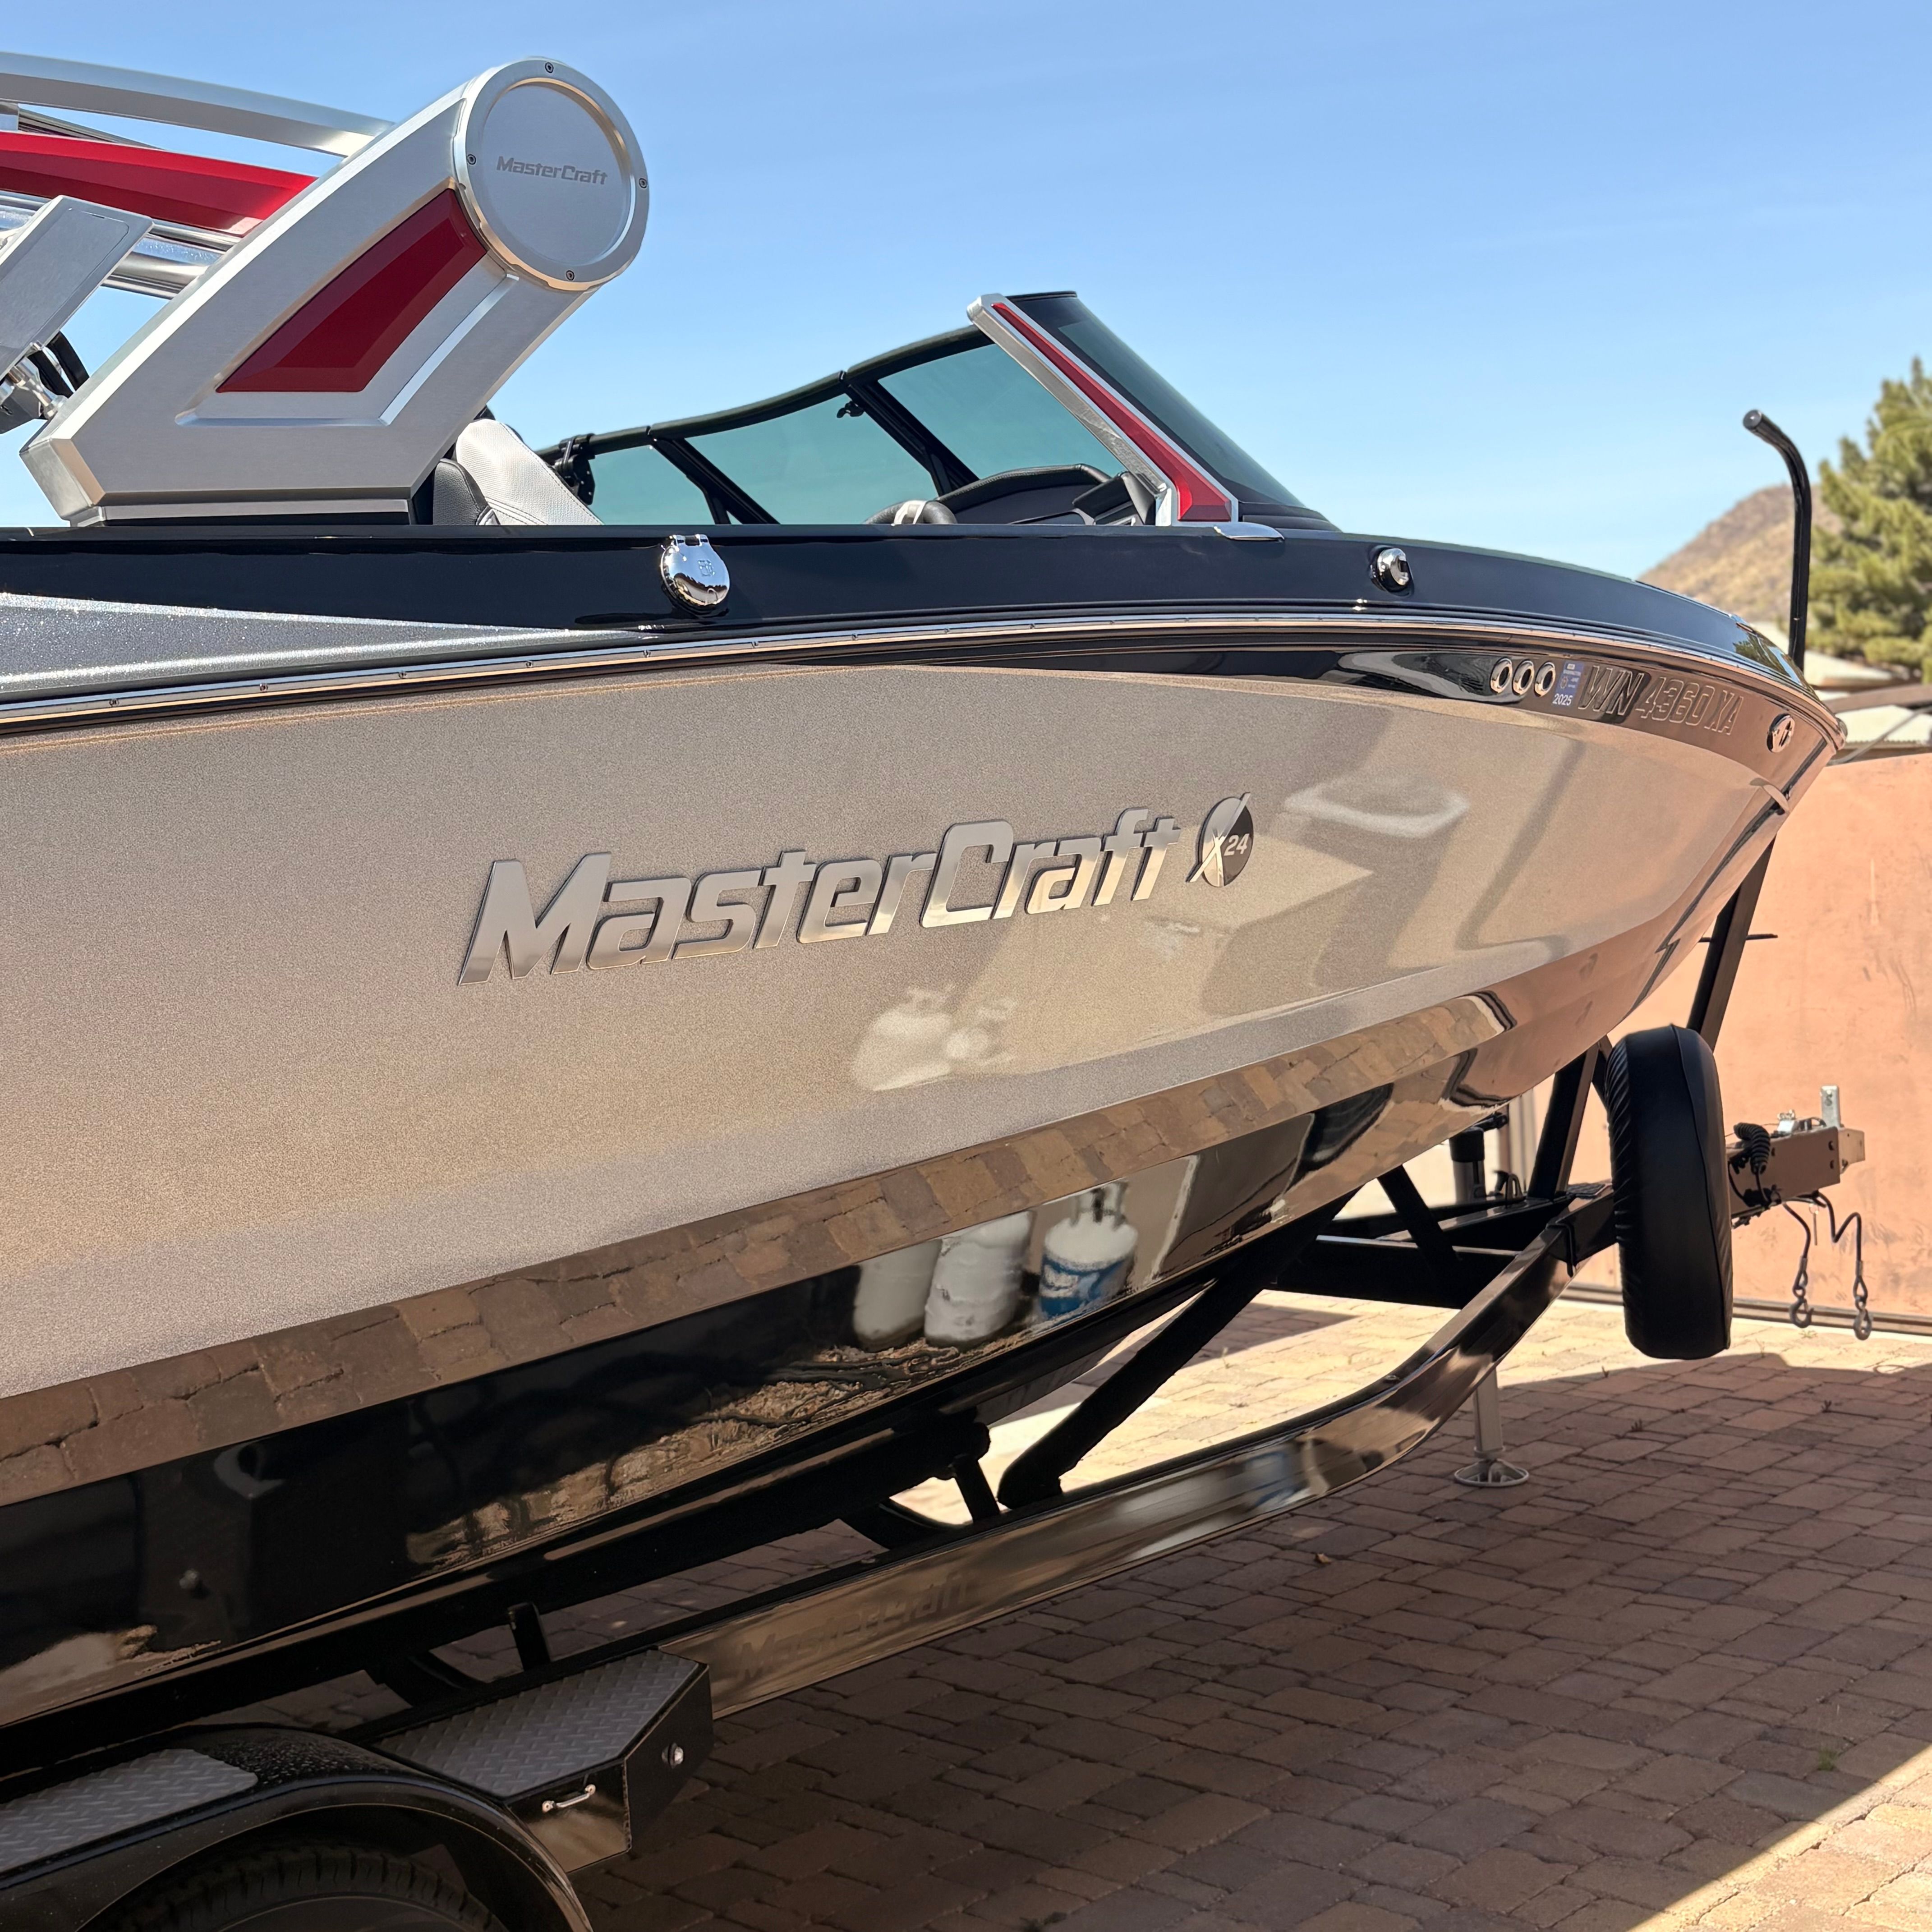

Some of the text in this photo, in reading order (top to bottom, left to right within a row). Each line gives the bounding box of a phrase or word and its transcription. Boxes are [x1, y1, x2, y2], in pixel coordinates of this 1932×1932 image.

[496, 156, 607, 184] MasterCraft
[1552, 693, 1573, 706] 2025
[1578, 665, 1744, 735] WN 4360 XA
[459, 808, 1182, 986] MasterCraft
